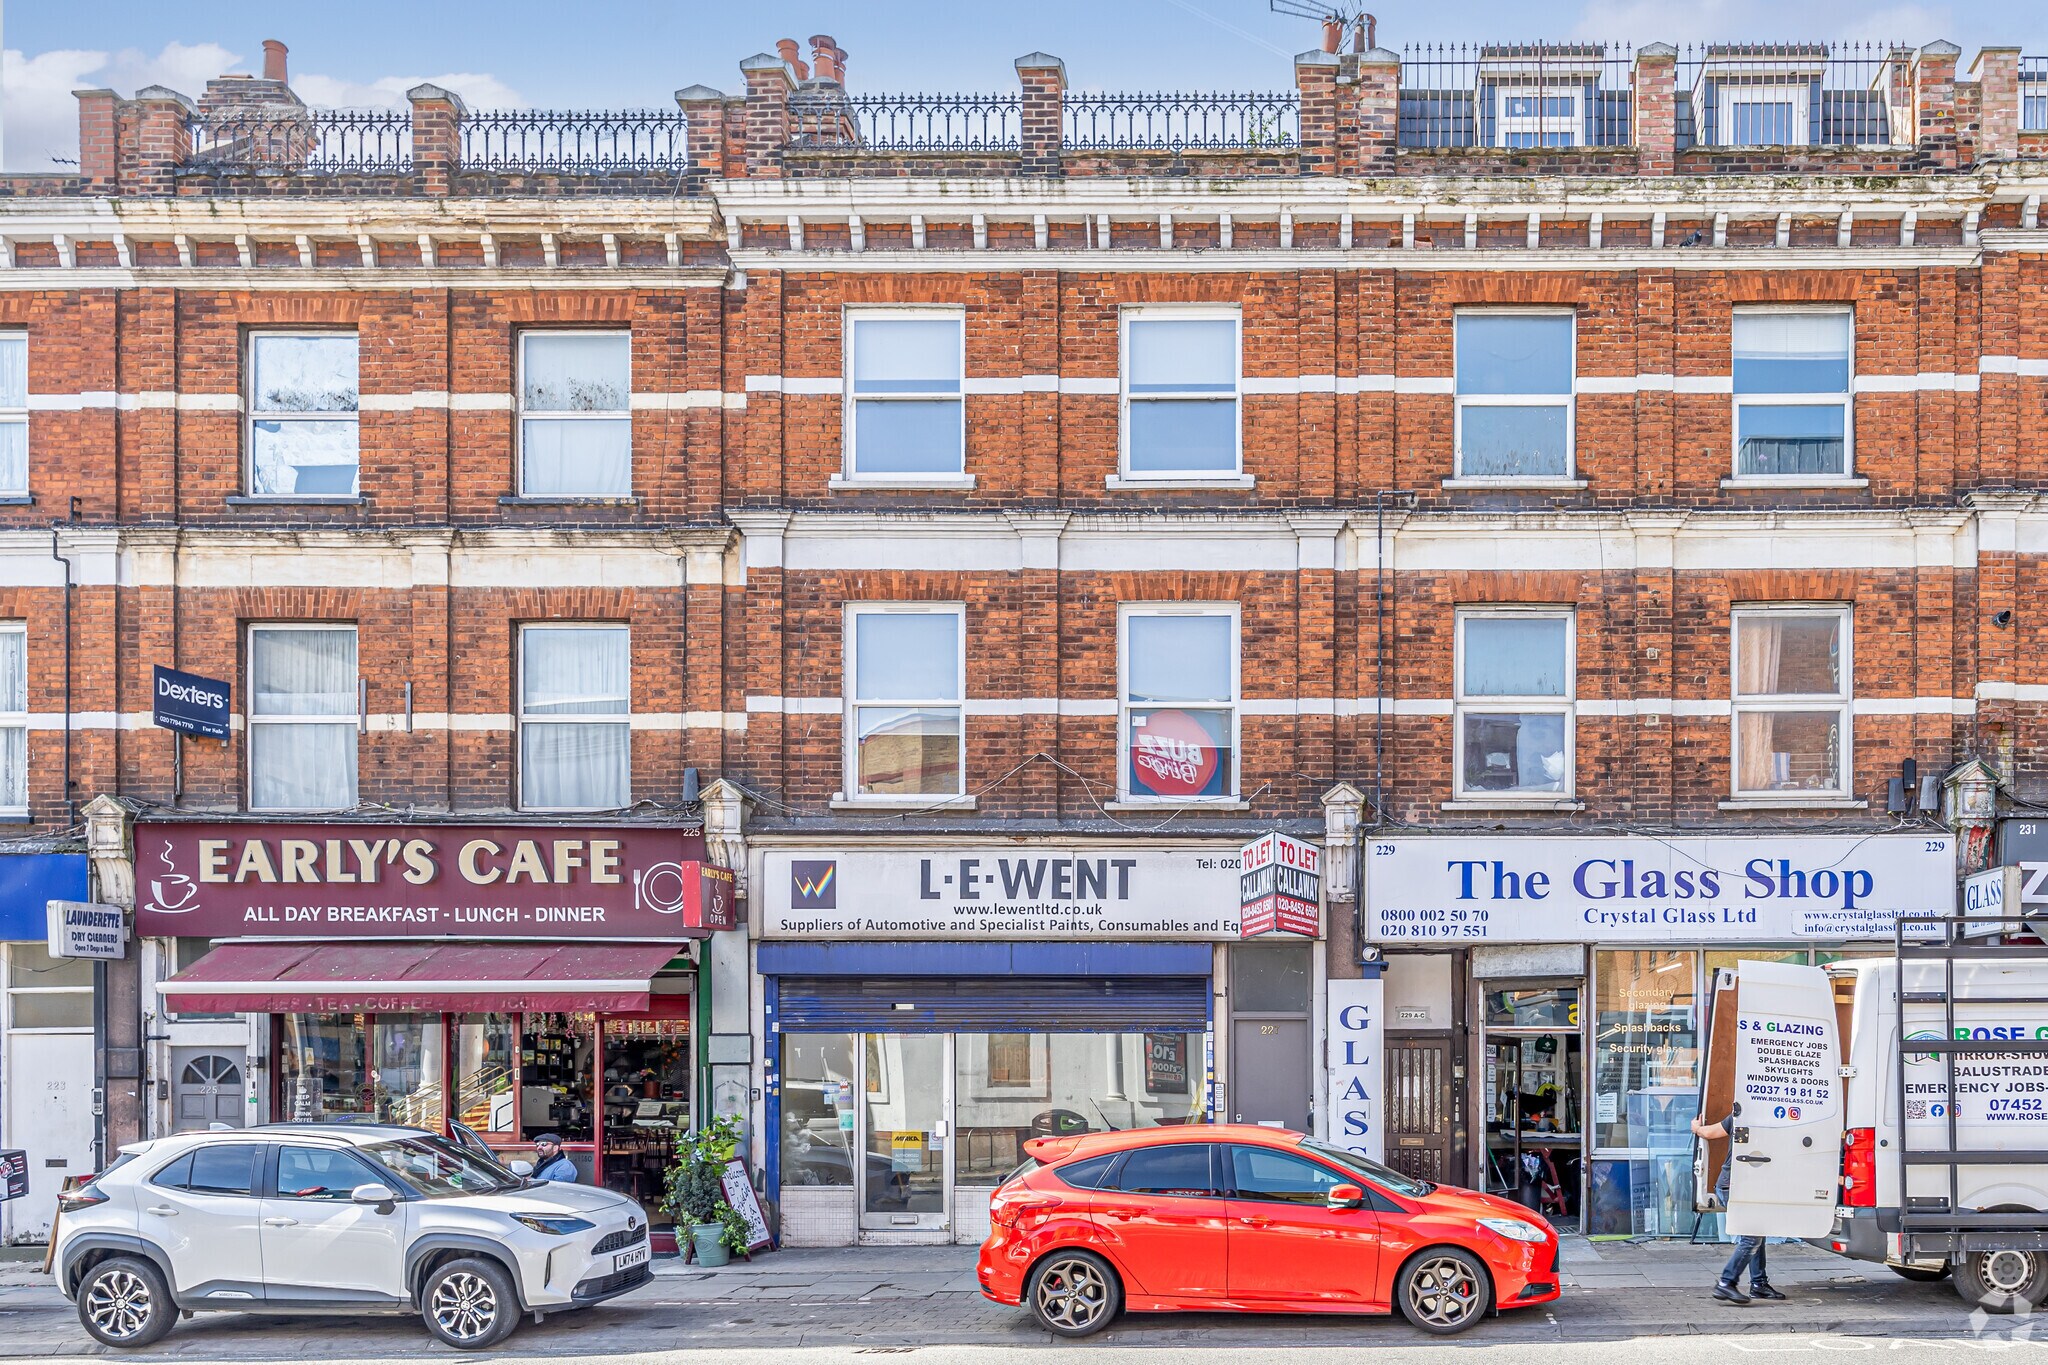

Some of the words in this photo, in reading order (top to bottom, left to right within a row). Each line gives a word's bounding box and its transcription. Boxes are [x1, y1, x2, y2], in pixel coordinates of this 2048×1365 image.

[159, 677, 224, 709] Dexters
[160, 716, 170, 724] 020
[683, 828, 700, 836] 225
[2019, 824, 2036, 835] 231
[1376, 845, 1396, 856] 229
[1925, 842, 1945, 852] 229
[1243, 848, 1254, 870] TO
[1256, 840, 1271, 866] LET
[1280, 841, 1295, 864] TO
[1298, 847, 1317, 871] LET
[199, 838, 437, 885] EARLY'S
[458, 839, 622, 885] CAFE
[1196, 858, 1216, 869] Tel:
[720, 872, 732, 882] CAFE
[1242, 866, 1274, 903] CALLAWAY
[1277, 866, 1318, 902] CALLAWAY
[1447, 860, 1550, 900] The
[1572, 859, 1720, 900] Glass
[1744, 859, 1874, 910] Shop
[1967, 878, 2002, 910] GLASS
[244, 906, 280, 922] ALL
[285, 907, 322, 922] DAY
[327, 907, 440, 922] BREAKFAST
[454, 908, 518, 922] LUNCH
[535, 908, 606, 922] DINNER
[954, 903, 1102, 915] www.lewentltd.co.uk
[1278, 898, 1304, 916] 020-8452
[1305, 905, 1318, 919] 6501
[66, 910, 120, 928] LAUNDERETTE
[710, 914, 726, 926] OPEN
[1381, 910, 1415, 922] 0800
[1420, 910, 1445, 922] 002
[1450, 910, 1467, 922] 50
[1472, 910, 1489, 922] 70
[1584, 908, 1656, 927] Crystal
[1663, 908, 1716, 923] Glass
[1722, 908, 1757, 923] Ltd
[780, 918, 843, 932] Suppliers
[847, 918, 862, 930] of
[865, 918, 946, 931] Automotive
[950, 919, 975, 931] and
[979, 919, 1045, 933] Specialist
[1050, 920, 1094, 933] Paints,
[1098, 918, 1189, 932] Consumables
[1193, 920, 1218, 932] and
[1381, 924, 1407, 937] 020
[1411, 924, 1437, 937] 810
[1442, 924, 1458, 937] 97
[1463, 924, 1488, 937] 551
[72, 932, 86, 942] DRY
[1619, 988, 1675, 998] Secondary
[1628, 1001, 1666, 1011] glazing
[1614, 1022, 1682, 1034] Splashbacks
[1752, 1021, 1762, 1030] &
[1766, 1022, 1824, 1036] GLAZING
[1610, 1044, 1654, 1054] Security
[1656, 1044, 1684, 1054] glass
[1750, 1038, 1804, 1048] EMERGENCY
[1758, 1048, 1792, 1056] DOUBLE
[1794, 1050, 1822, 1058] GLAZE
[1758, 1057, 1820, 1068] SPLASHBACKS
[1764, 1066, 1814, 1076] SKYLIGHTS
[46, 1081, 66, 1090] 223
[1746, 1074, 1789, 1083] WINDOWS
[1800, 1078, 1829, 1086] DOORS
[200, 1085, 218, 1094] 225
[1746, 1084, 1780, 1094] 02037
[1784, 1087, 1796, 1096] 19
[1800, 1088, 1812, 1097] 81
[1816, 1090, 1828, 1098] 52
[1751, 1096, 1824, 1106] WWW.ROSEGLASS.CO.UK
[1990, 1098, 2042, 1111] 07452
